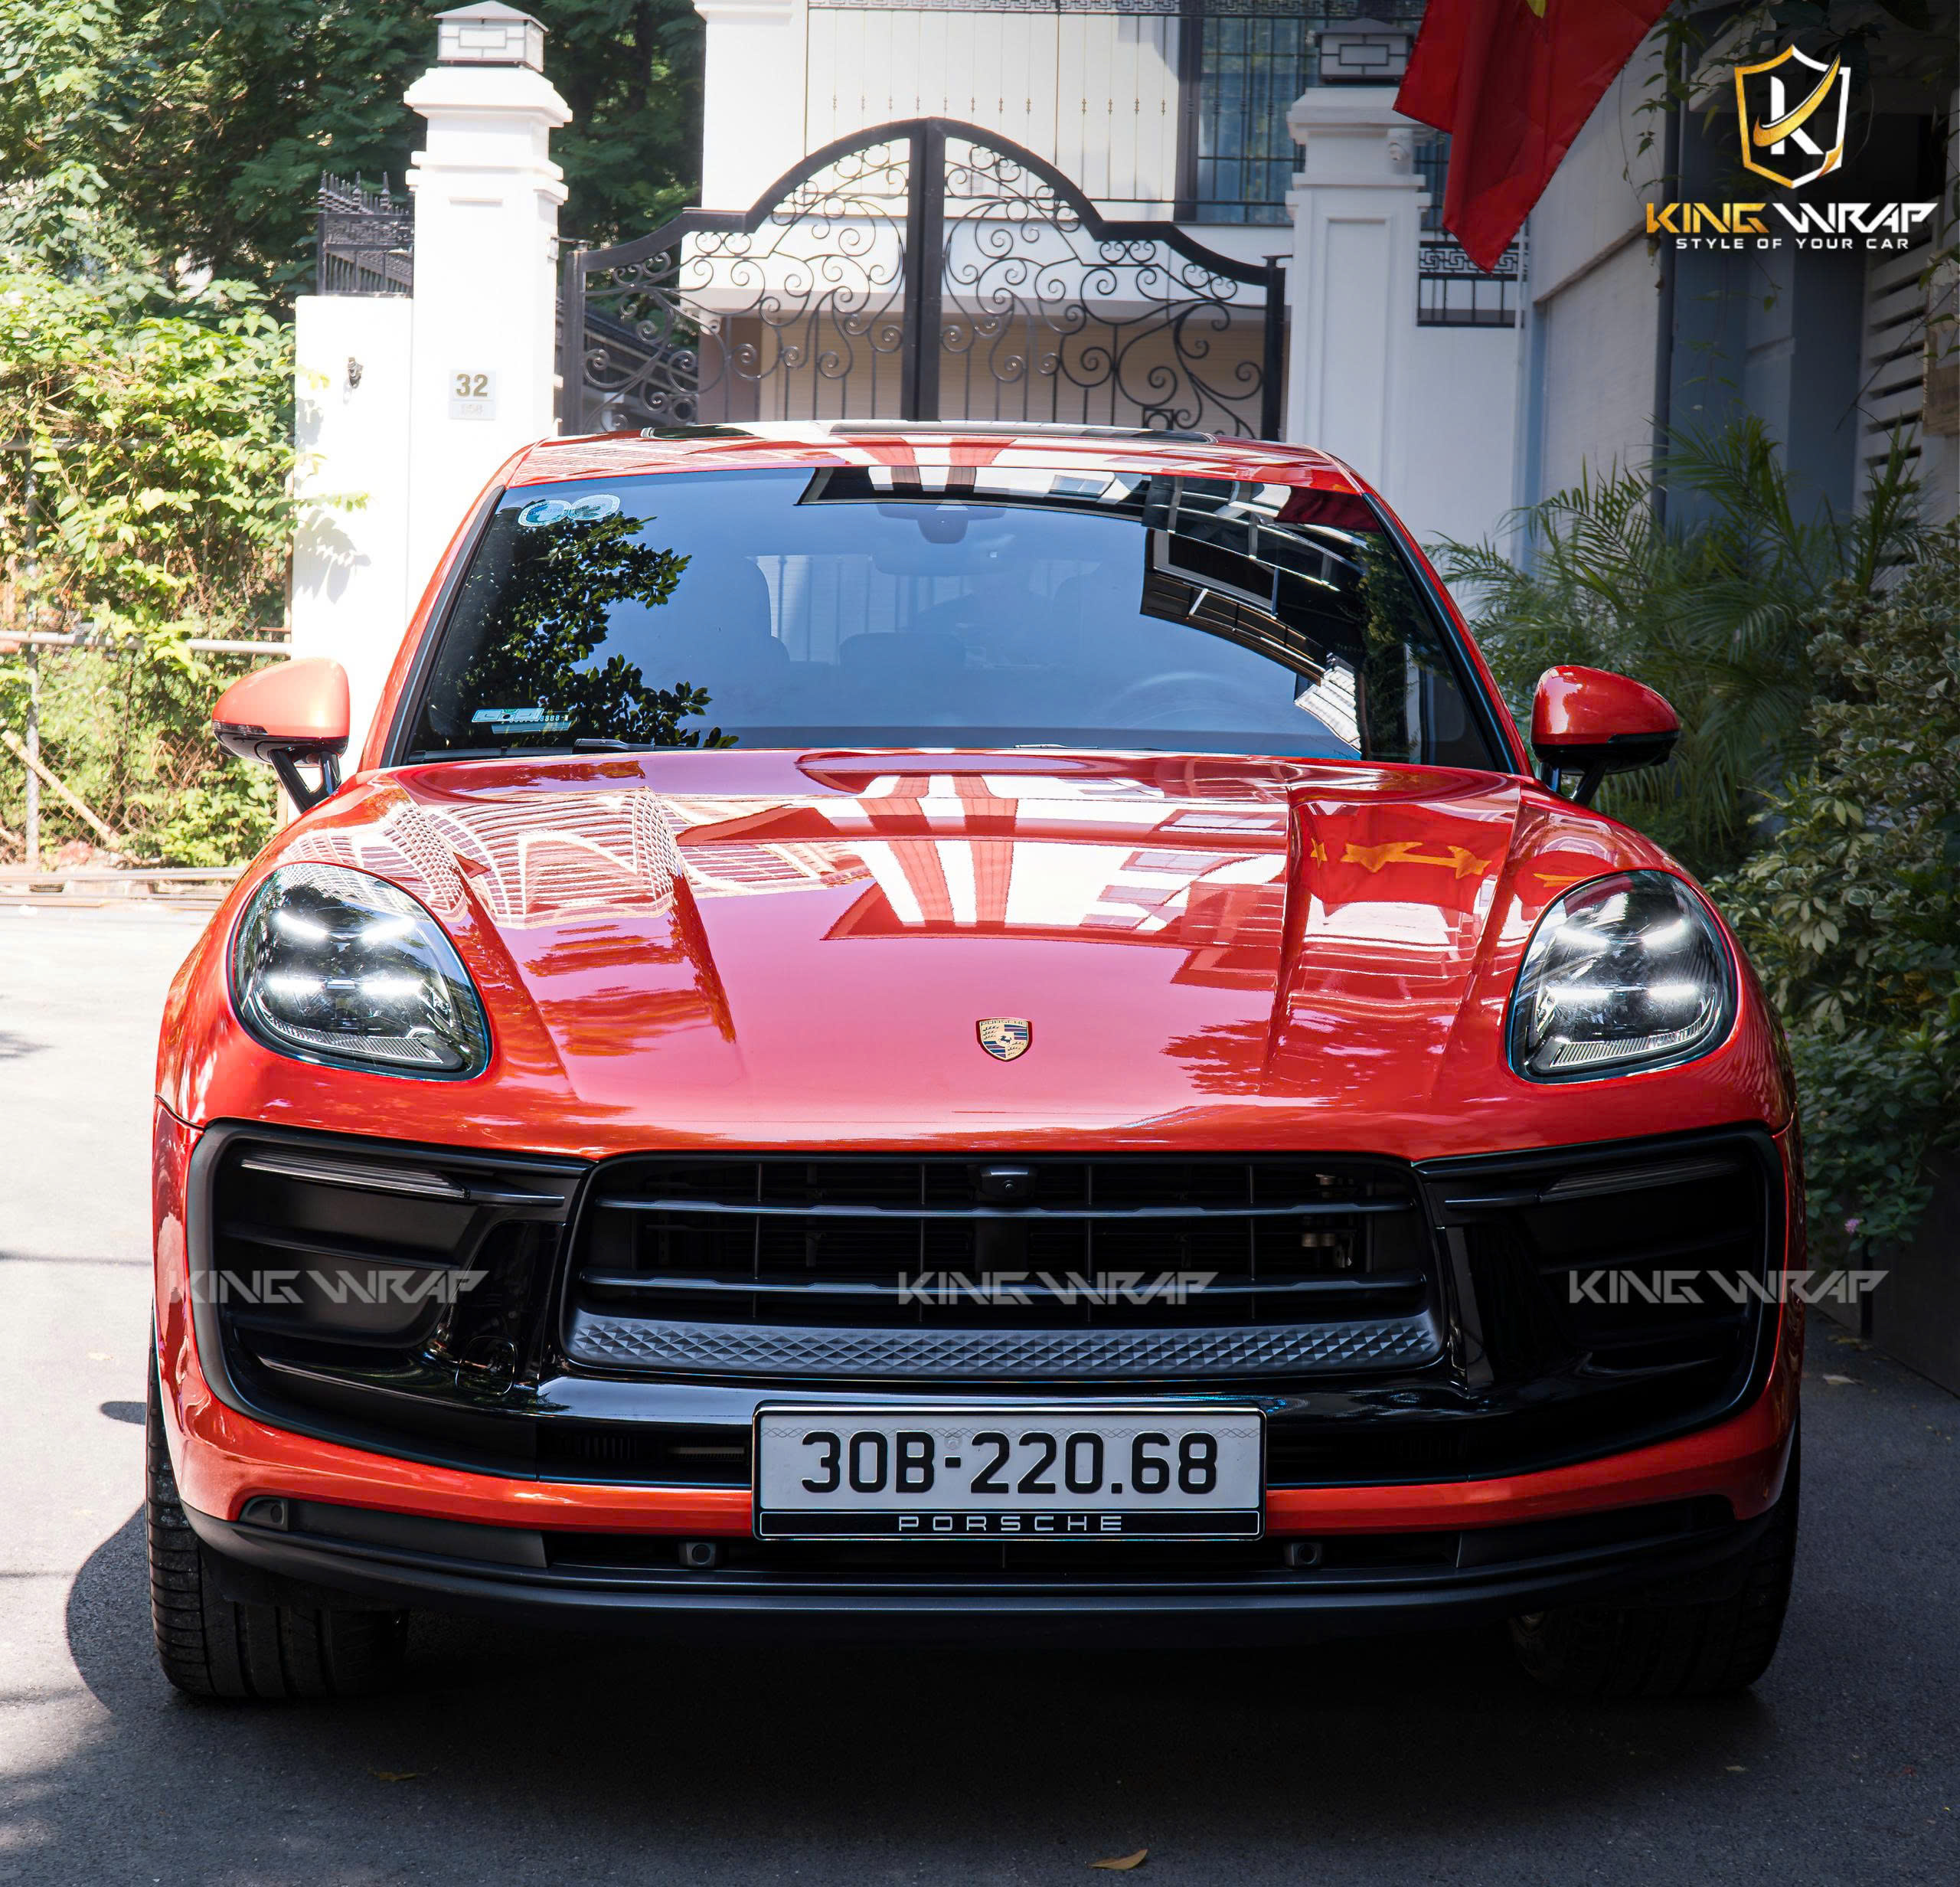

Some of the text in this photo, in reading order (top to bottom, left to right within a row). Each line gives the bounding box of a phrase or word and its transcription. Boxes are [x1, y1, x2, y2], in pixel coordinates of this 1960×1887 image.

[456, 373, 488, 397] 32
[800, 1430, 1218, 1495] 30B-220.68
[898, 1516, 1123, 1532] PORSCHE
